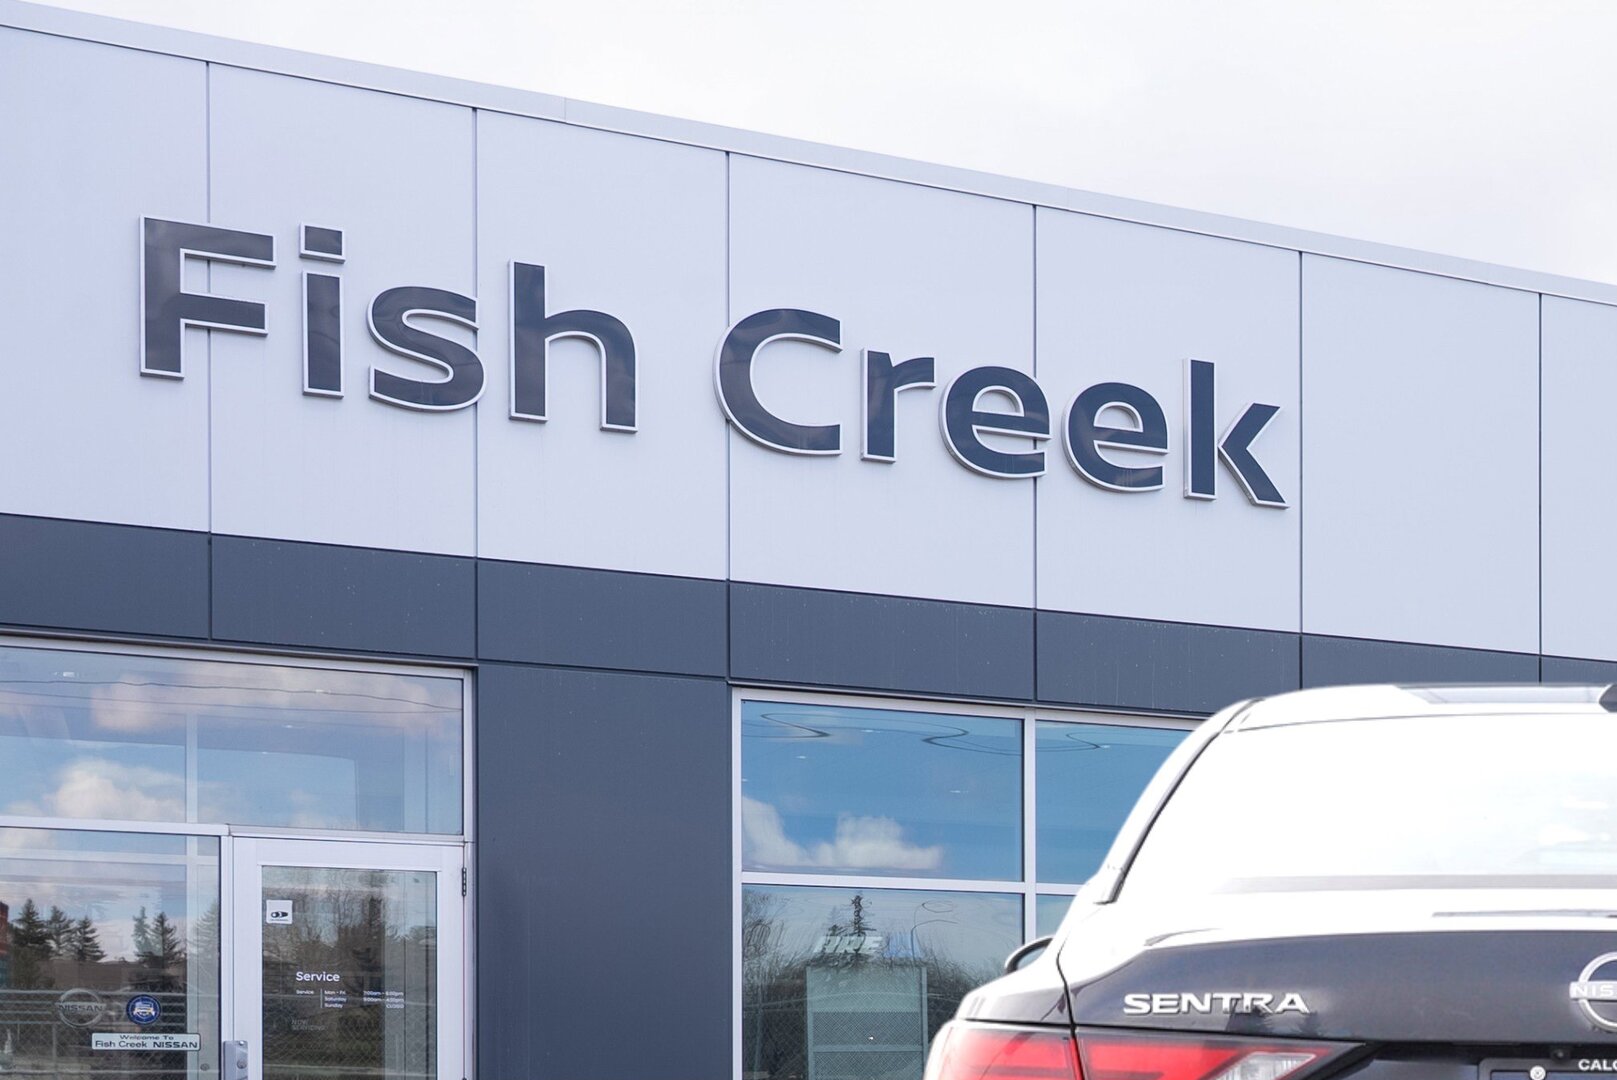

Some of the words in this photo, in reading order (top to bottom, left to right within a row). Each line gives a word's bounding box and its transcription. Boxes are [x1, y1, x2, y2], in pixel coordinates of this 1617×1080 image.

[138, 216, 638, 435] Fish
[713, 307, 1291, 509] Creek
[296, 971, 341, 982] Service
[58, 1004, 103, 1012] NISSAN
[1123, 993, 1310, 1015] SENTRA
[95, 1040, 116, 1048] Fish
[118, 1040, 148, 1048] Creek
[153, 1041, 198, 1049] NISSAN
